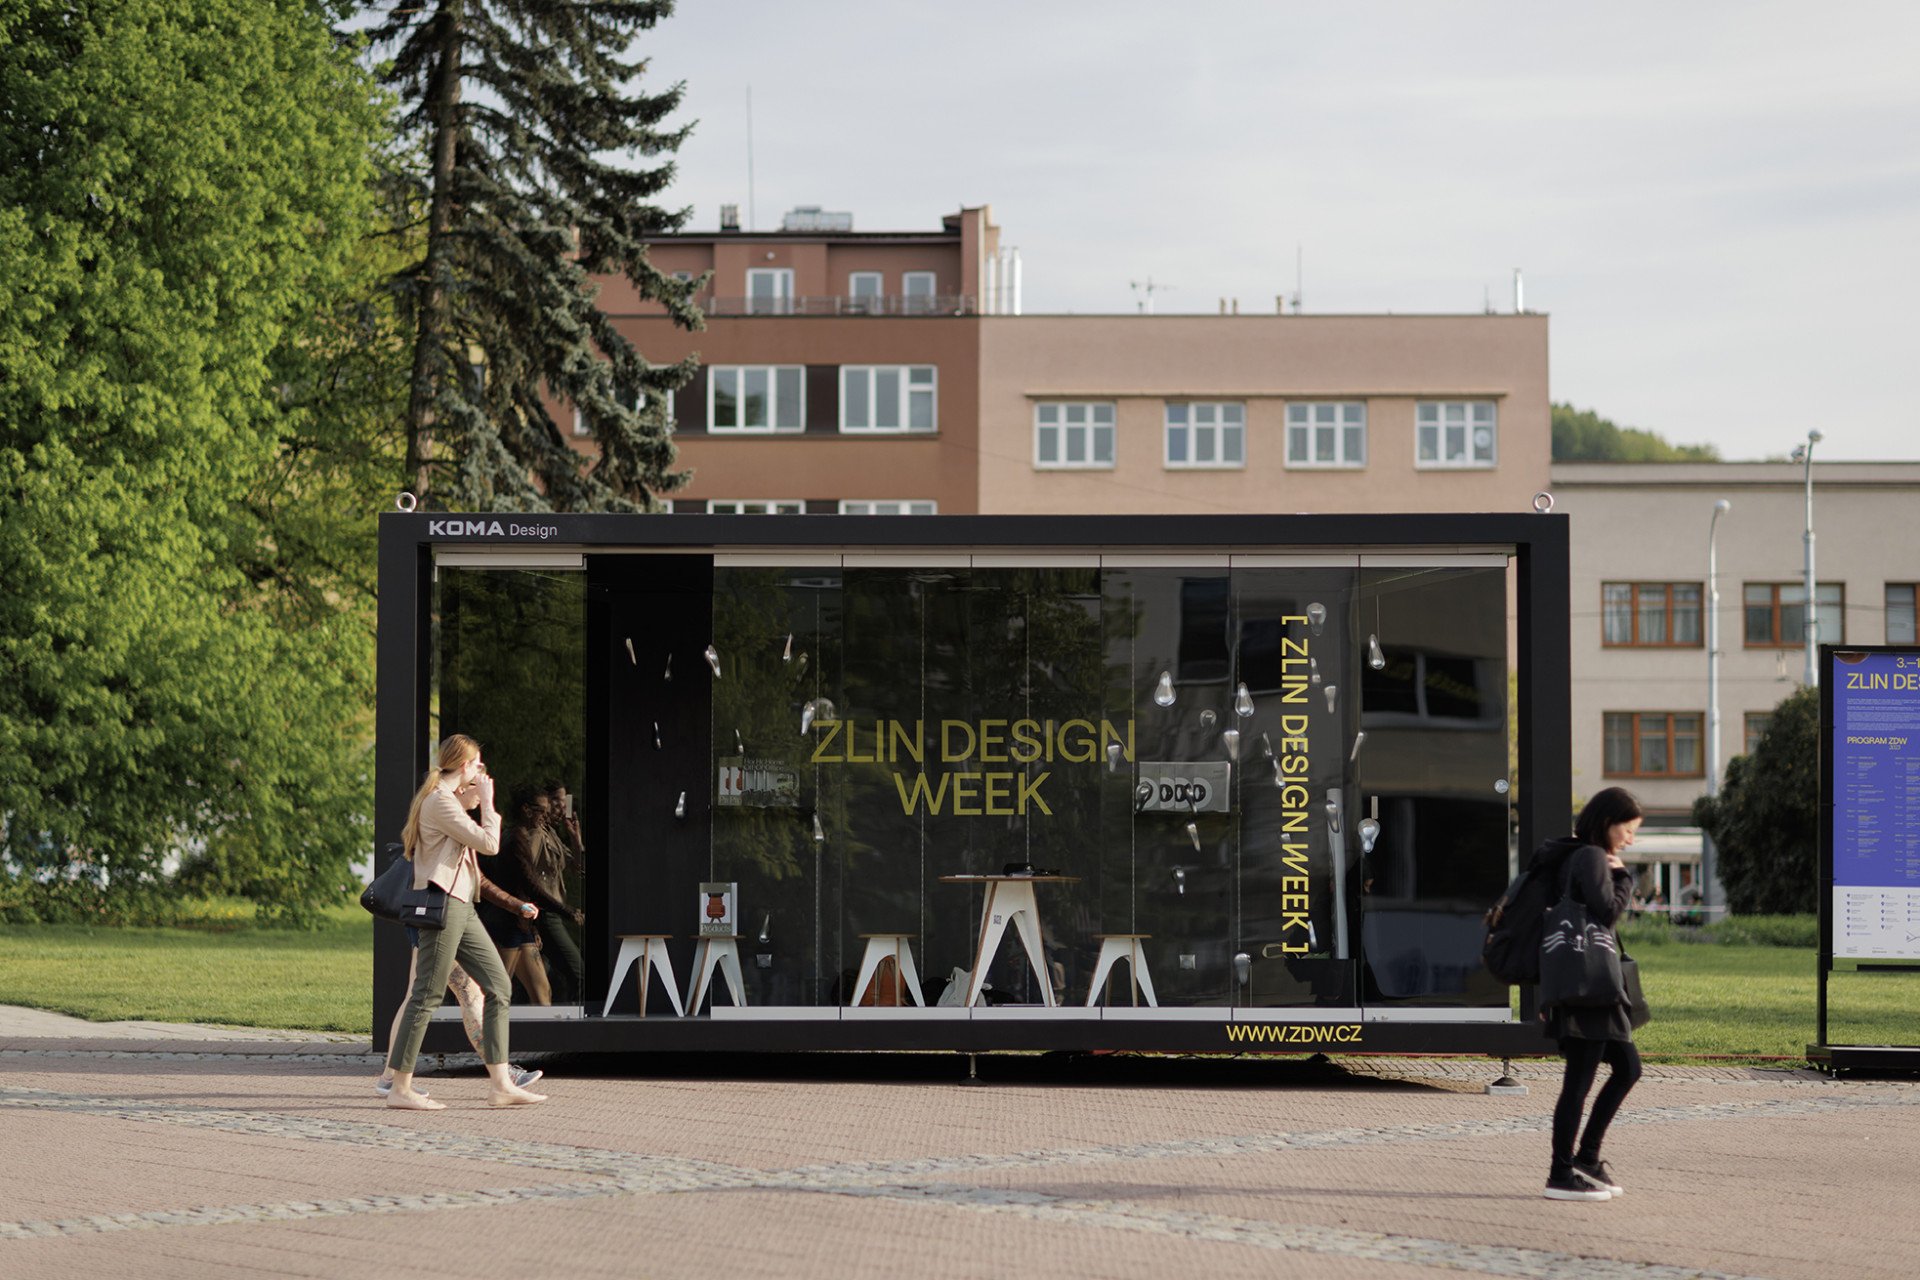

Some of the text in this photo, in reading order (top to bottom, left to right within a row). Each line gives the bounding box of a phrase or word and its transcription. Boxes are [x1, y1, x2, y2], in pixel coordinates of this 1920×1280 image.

[429, 521, 557, 539] KOMA Design
[1281, 637, 1308, 703] ZLIN
[1847, 673, 1920, 690] ZLIN DE
[811, 719, 1135, 763] ZLIN DESIGN
[1847, 736, 1907, 745] PROGRAM ZDW
[893, 772, 1052, 815] WEEK
[1281, 715, 1309, 832] DESIGN
[1282, 844, 1309, 931] WEEK
[1226, 1025, 1362, 1042] WWW.ZDW.CZ
